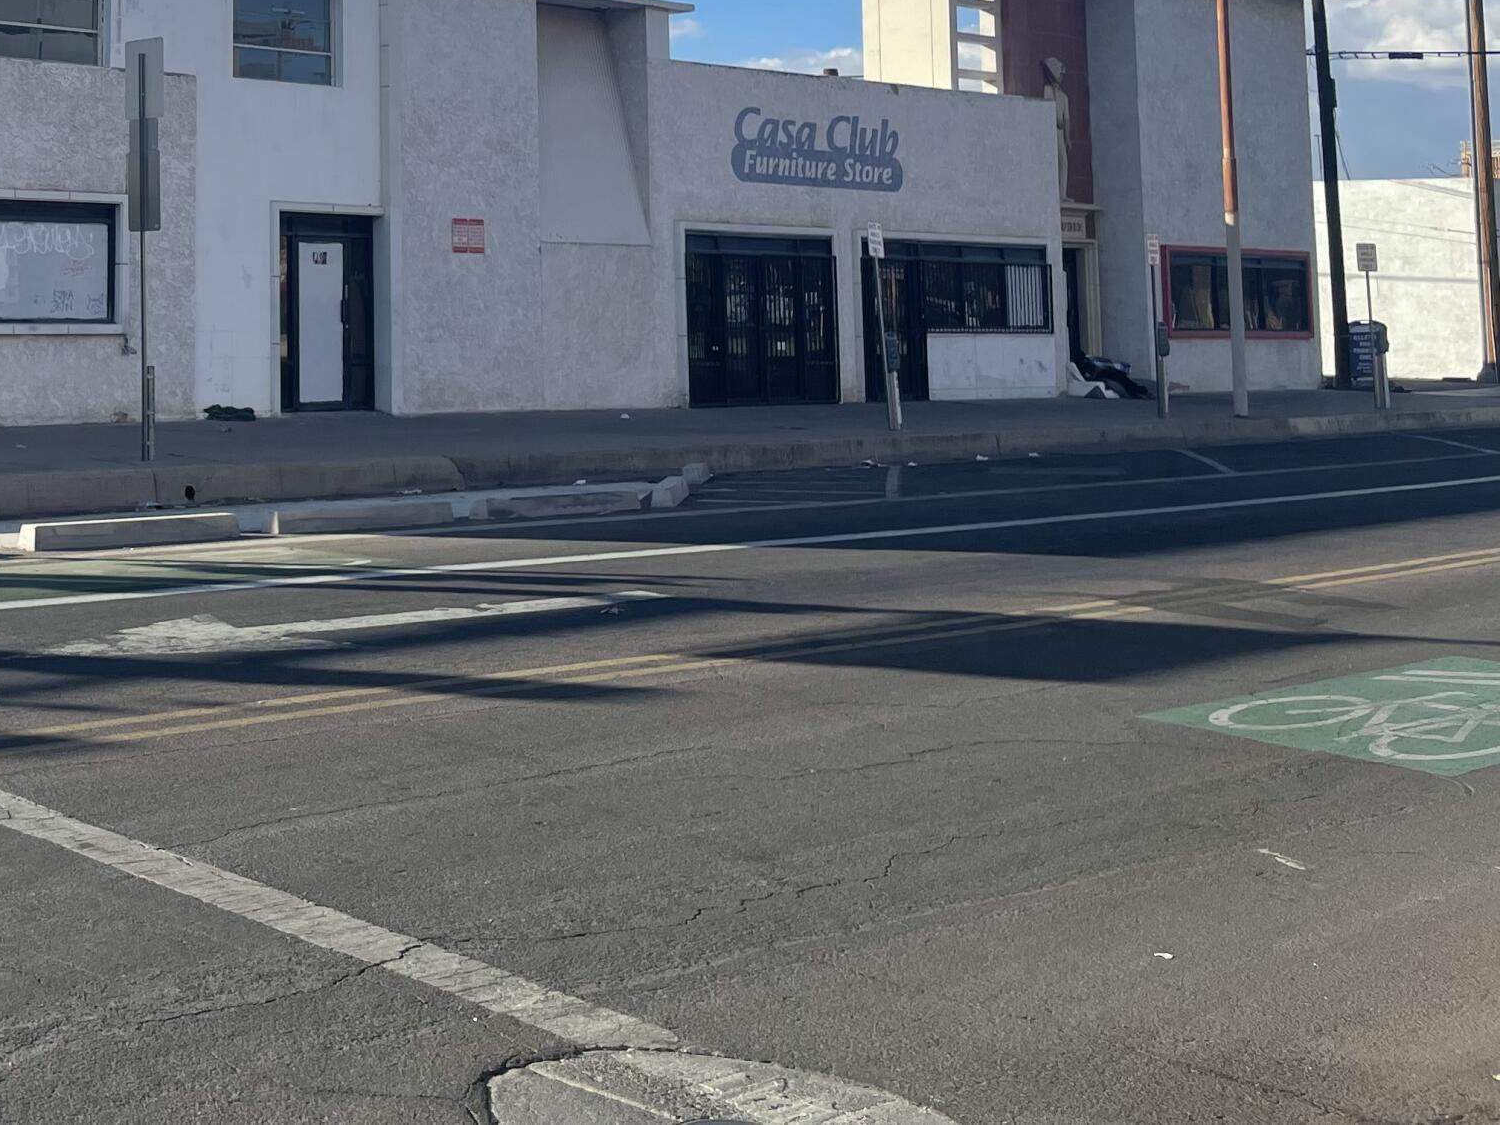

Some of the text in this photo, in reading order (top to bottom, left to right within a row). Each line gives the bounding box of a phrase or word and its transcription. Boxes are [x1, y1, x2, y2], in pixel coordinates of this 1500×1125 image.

[734, 106, 899, 157] Casa Club
[743, 150, 893, 185] Furniture Store
